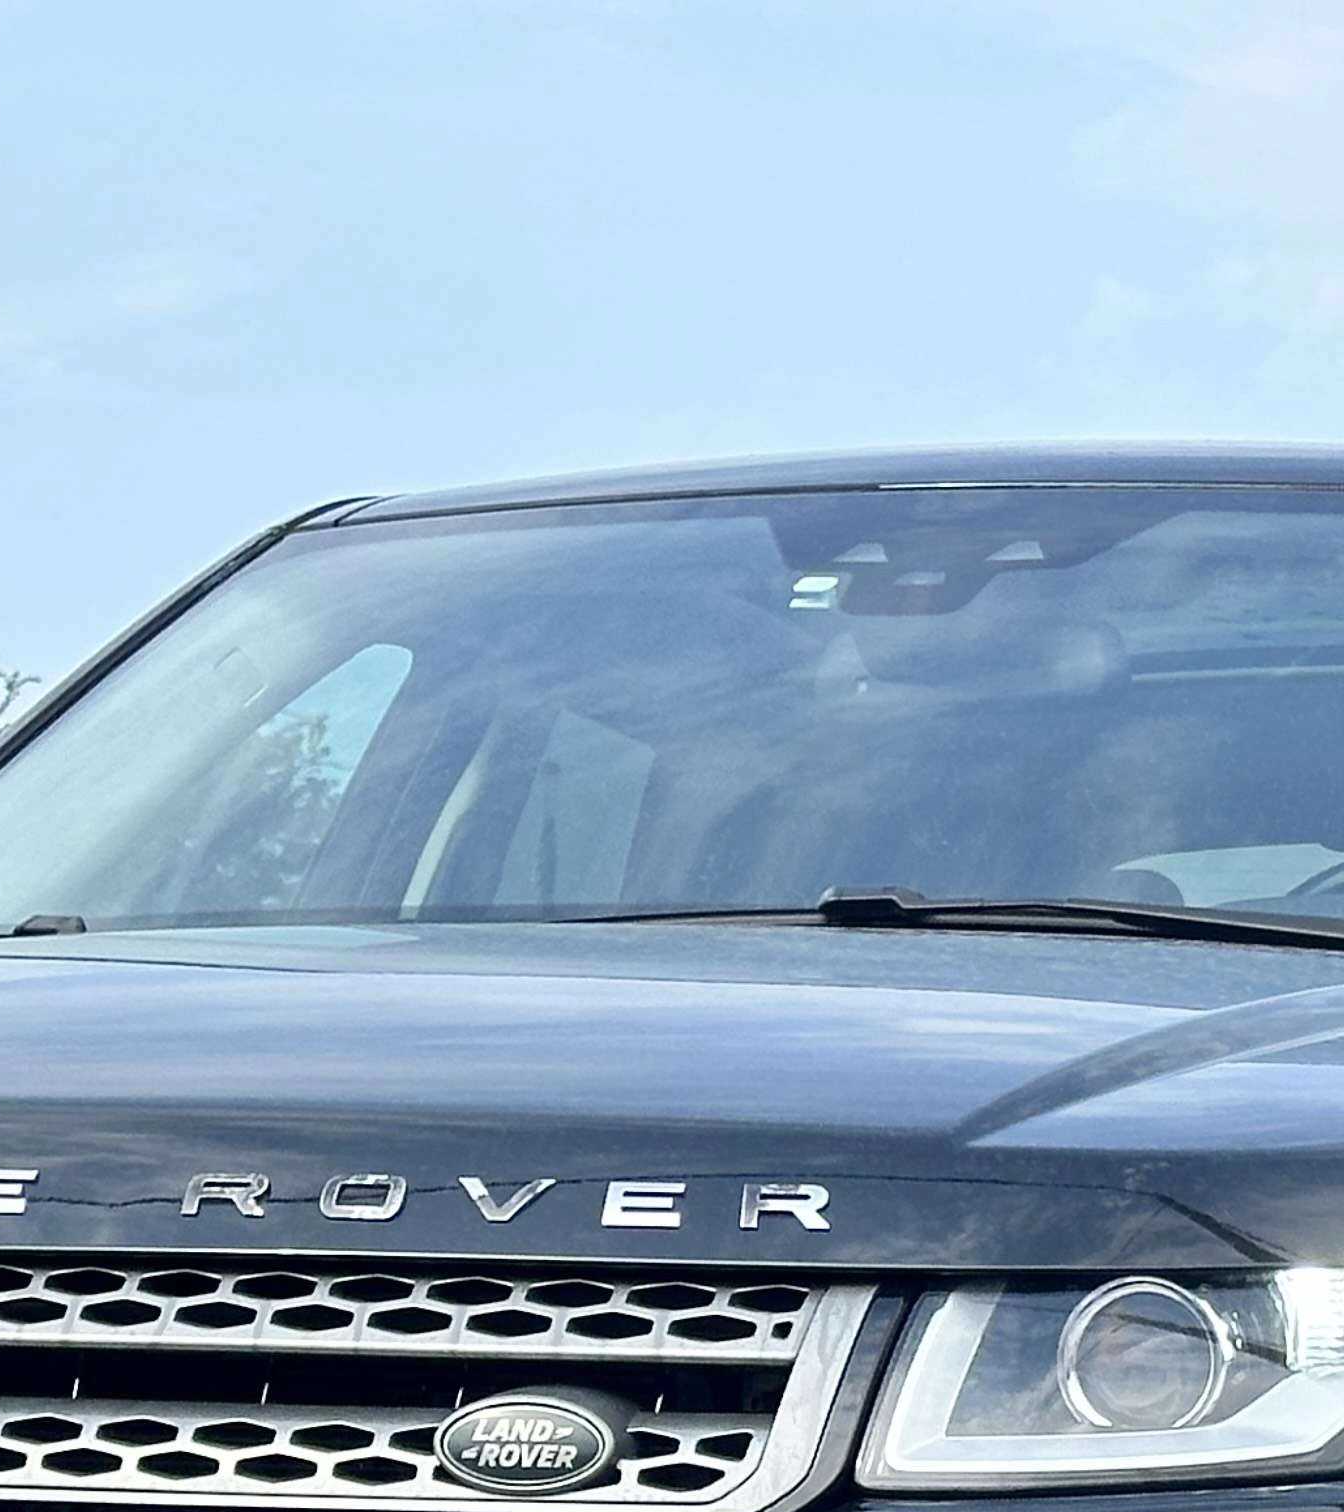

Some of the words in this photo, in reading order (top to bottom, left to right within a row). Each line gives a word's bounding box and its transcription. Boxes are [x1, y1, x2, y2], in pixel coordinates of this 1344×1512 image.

[179, 1171, 833, 1233] ROVER
[472, 1418, 557, 1442] LAND
[477, 1443, 578, 1470] ROVER
